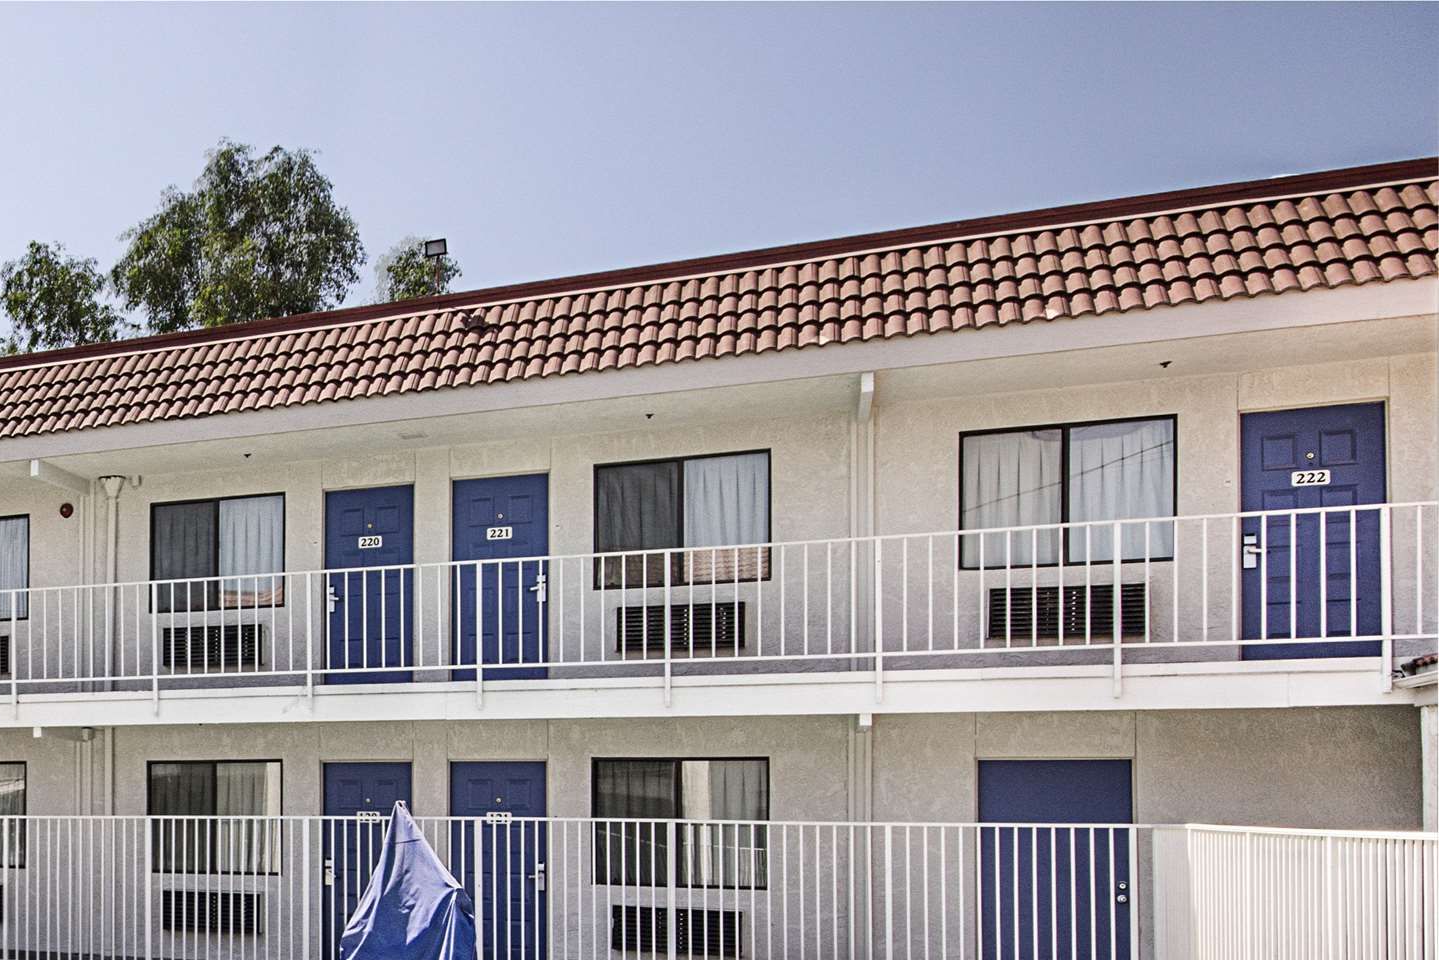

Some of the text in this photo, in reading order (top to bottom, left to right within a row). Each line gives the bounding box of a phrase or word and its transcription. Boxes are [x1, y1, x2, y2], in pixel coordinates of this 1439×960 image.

[1296, 472, 1326, 484] 222
[489, 529, 510, 538] 221
[360, 537, 380, 547] 220
